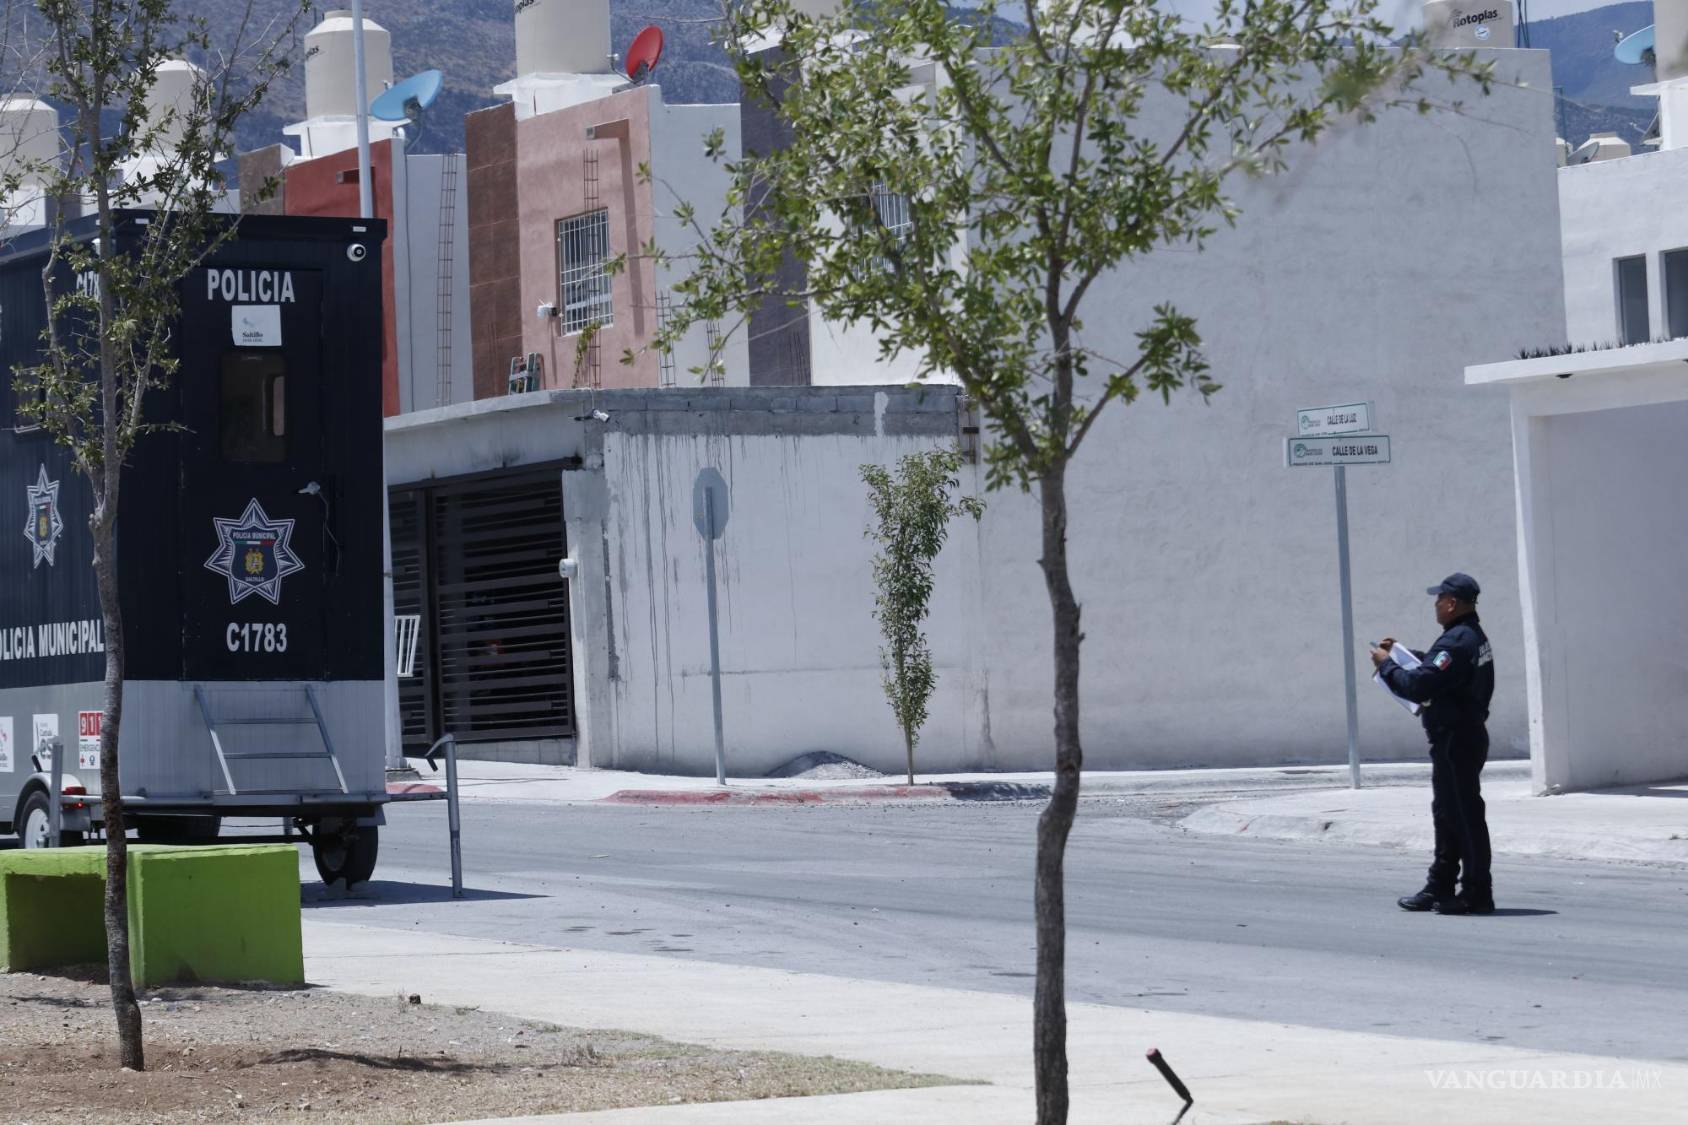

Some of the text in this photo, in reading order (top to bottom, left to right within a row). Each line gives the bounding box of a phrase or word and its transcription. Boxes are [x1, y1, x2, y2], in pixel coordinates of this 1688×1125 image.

[207, 268, 296, 303] POLICIA
[1332, 446, 1348, 456] CALLE
[1349, 446, 1356, 456] DE
[1357, 446, 1363, 456] LA
[1364, 445, 1378, 455] VEGA
[0, 618, 105, 660] LICIA MUNICIPAL
[226, 622, 287, 652] C1783
